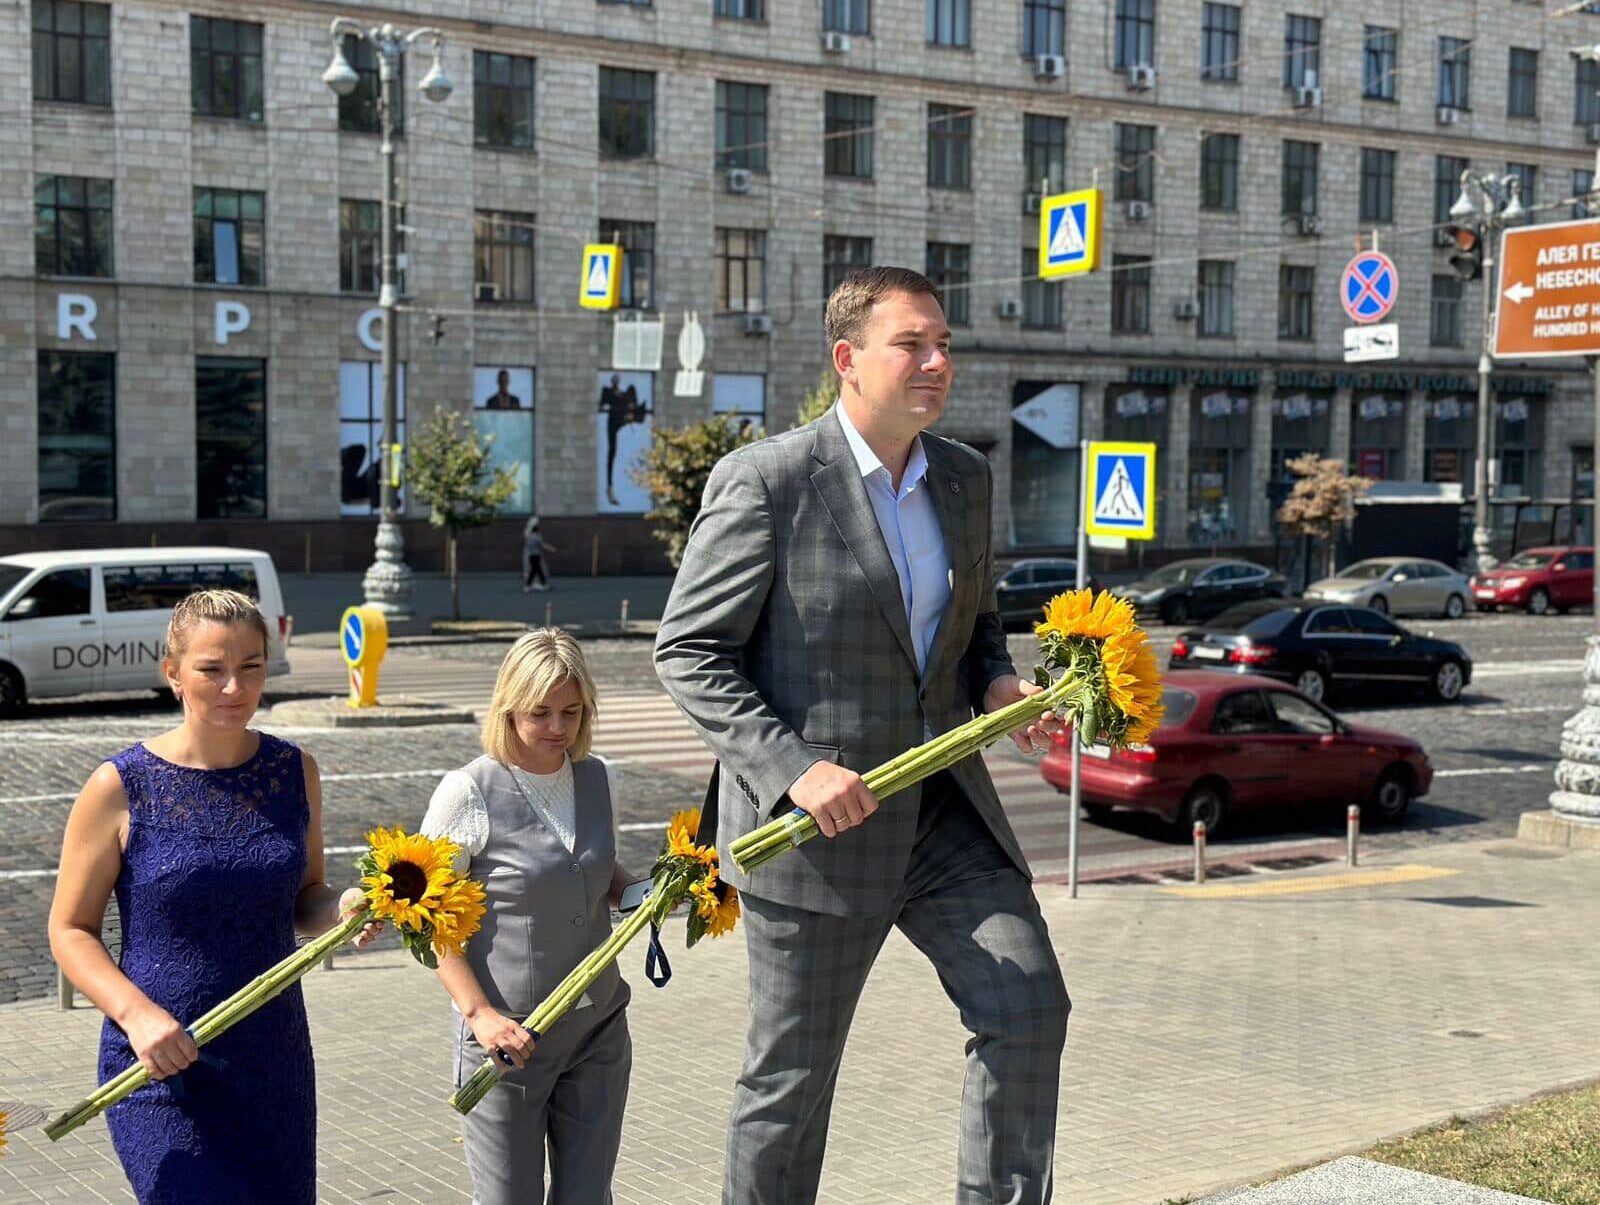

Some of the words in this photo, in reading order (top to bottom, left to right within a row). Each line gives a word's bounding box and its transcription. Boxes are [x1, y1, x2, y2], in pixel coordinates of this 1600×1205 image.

[1537, 245, 1578, 266] АЛЕЯ
[1535, 305, 1570, 320] ALLEY
[1573, 304, 1589, 317] OF
[1533, 322, 1588, 337] HUNDRED
